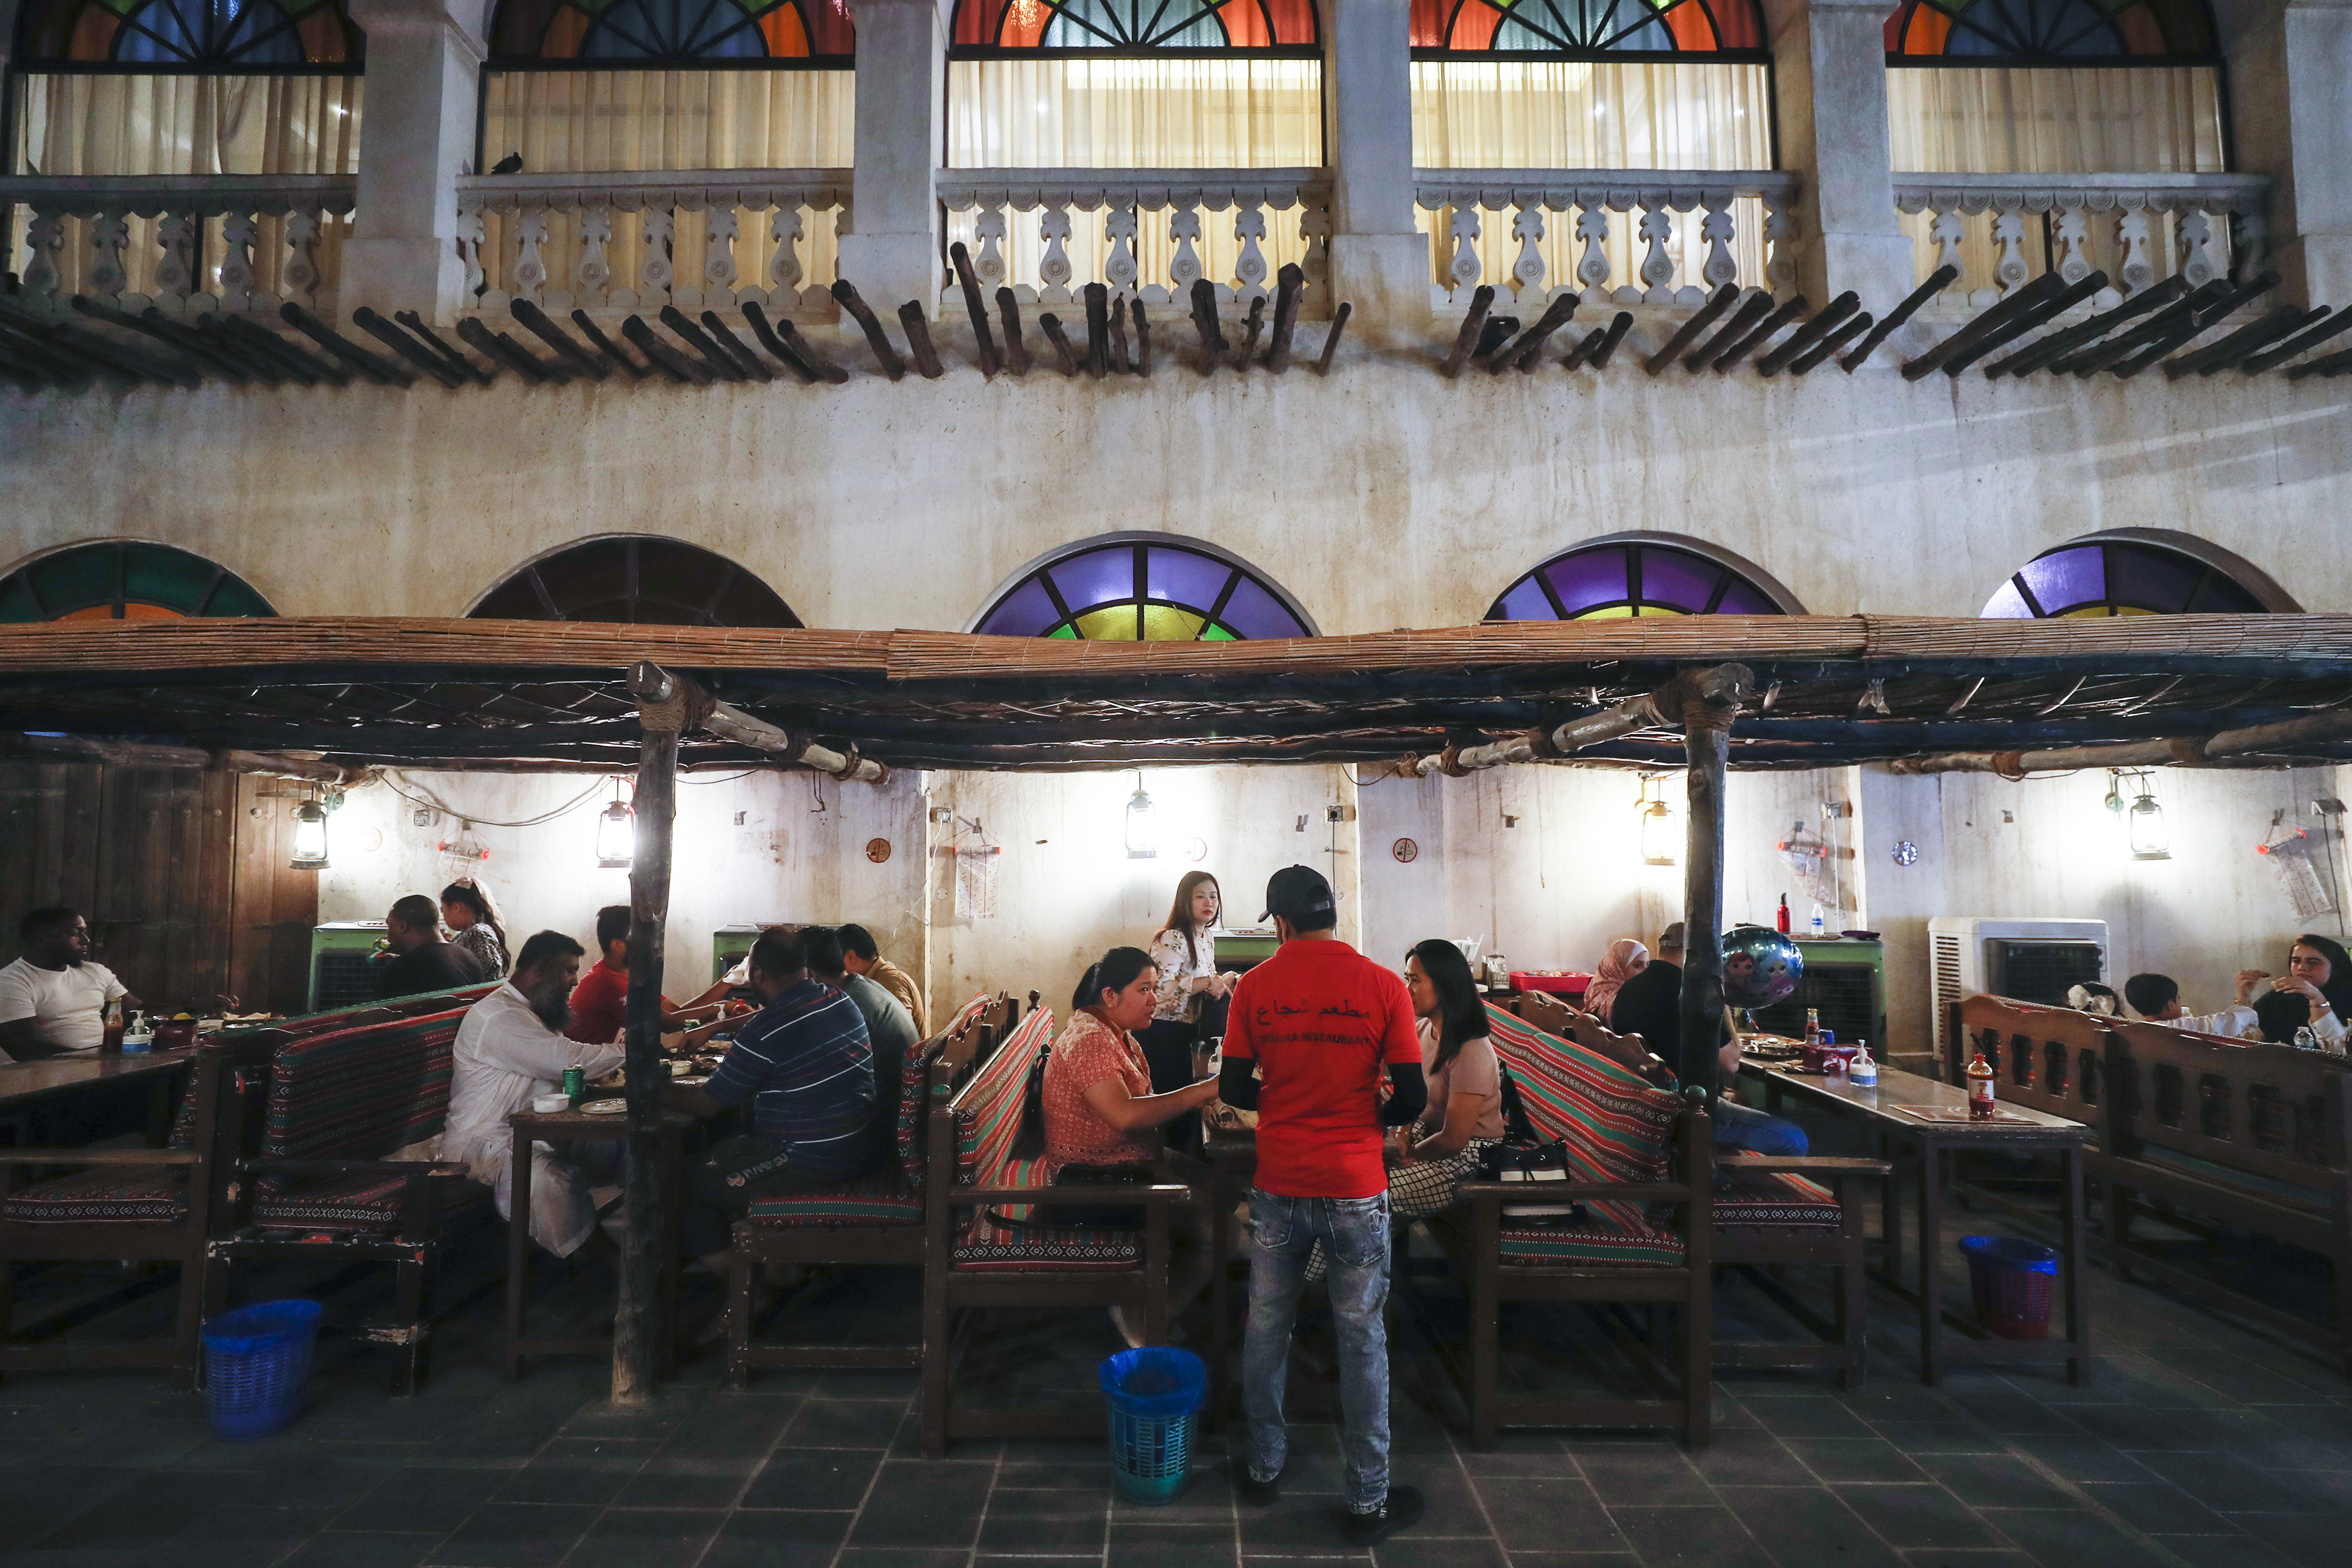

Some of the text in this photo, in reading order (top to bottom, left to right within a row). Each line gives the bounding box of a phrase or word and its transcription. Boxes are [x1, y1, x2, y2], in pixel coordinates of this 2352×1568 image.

[1256, 998, 1371, 1026] مطعم شجاع
[1302, 1032, 1371, 1045] RESTAURANT
